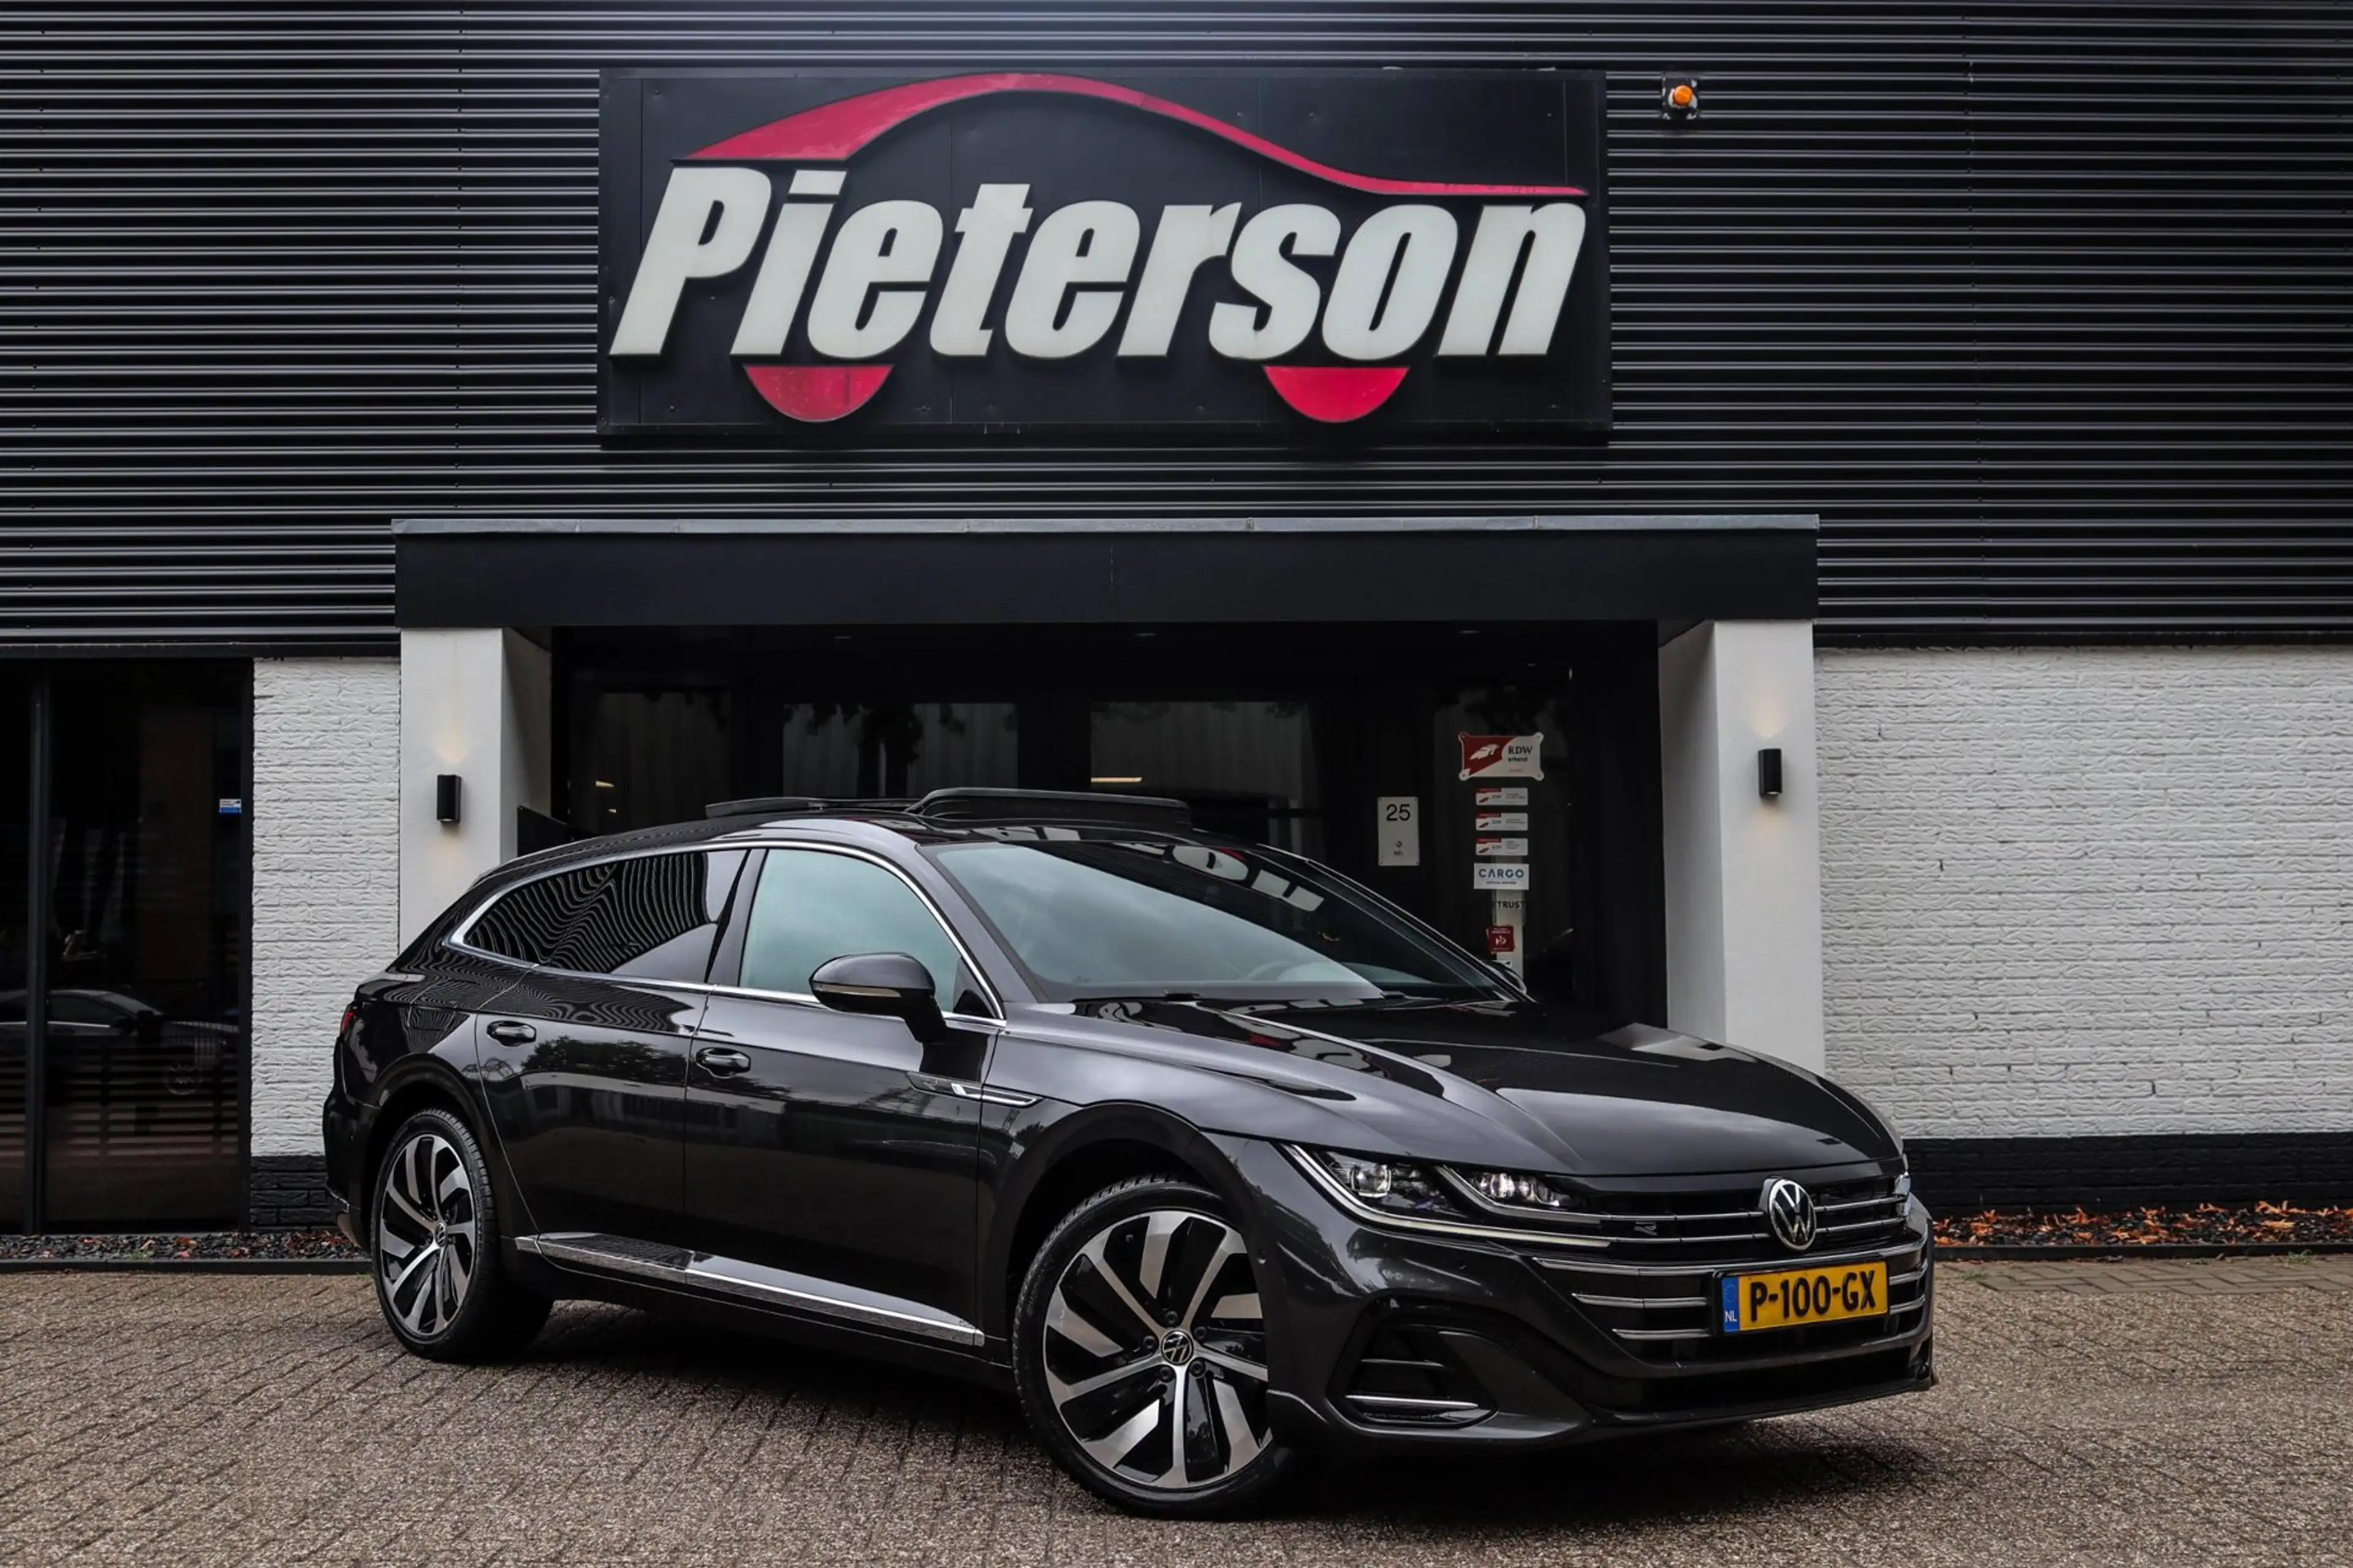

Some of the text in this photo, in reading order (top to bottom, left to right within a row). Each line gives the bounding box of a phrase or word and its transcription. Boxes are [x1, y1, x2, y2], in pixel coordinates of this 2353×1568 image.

[608, 165, 1587, 360] Pieterson
[1508, 745, 1533, 754] RDW
[1386, 803, 1411, 821] 25
[1479, 868, 1525, 878] CARGO
[1750, 1270, 1876, 1322] P-100-GX
[1724, 1310, 1738, 1322] NL
